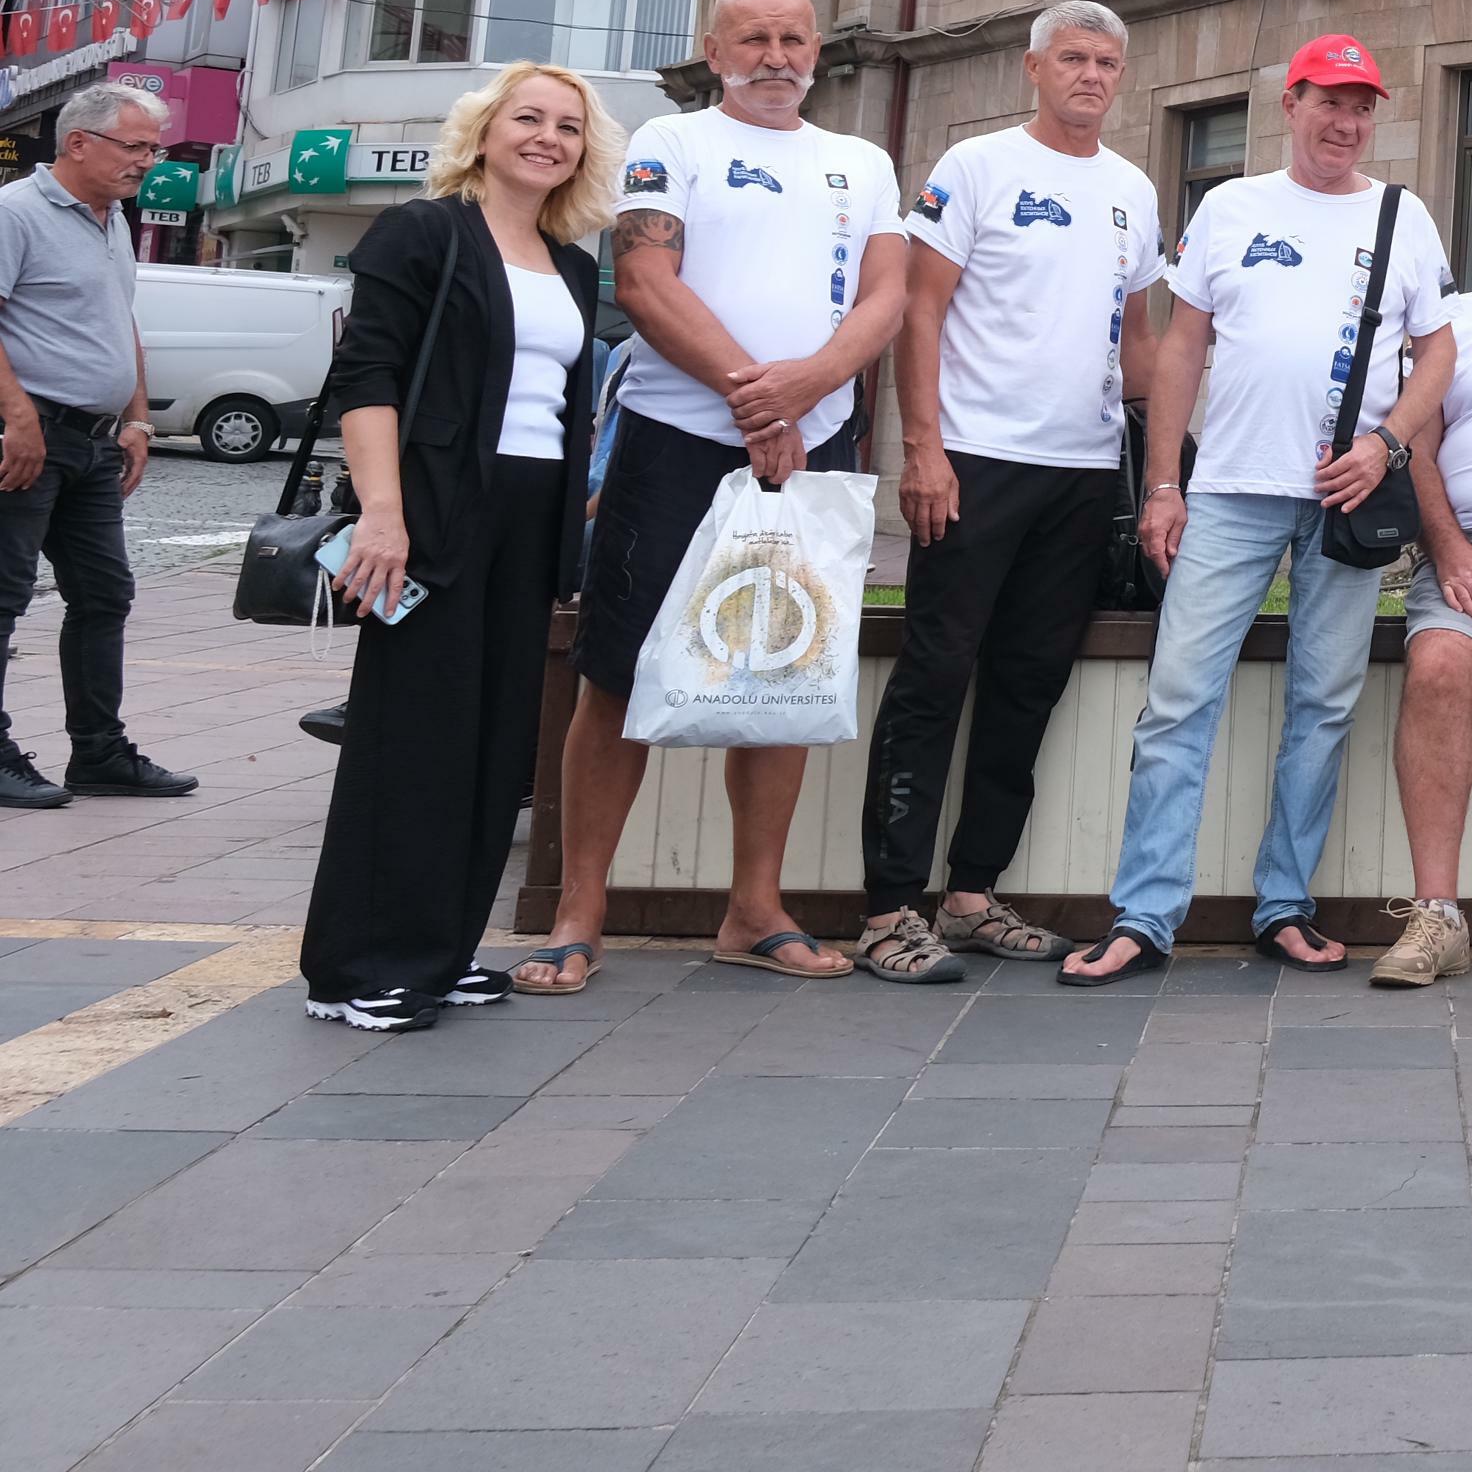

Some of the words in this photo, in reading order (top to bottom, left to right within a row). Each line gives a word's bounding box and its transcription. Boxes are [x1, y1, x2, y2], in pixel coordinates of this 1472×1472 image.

[119, 73, 164, 93] eve
[372, 150, 429, 173] TEB
[251, 162, 271, 185] TEB
[148, 211, 181, 223] TEB
[693, 694, 757, 705] ANADOLU
[761, 692, 837, 705] ÜNİVERSİTESİ
